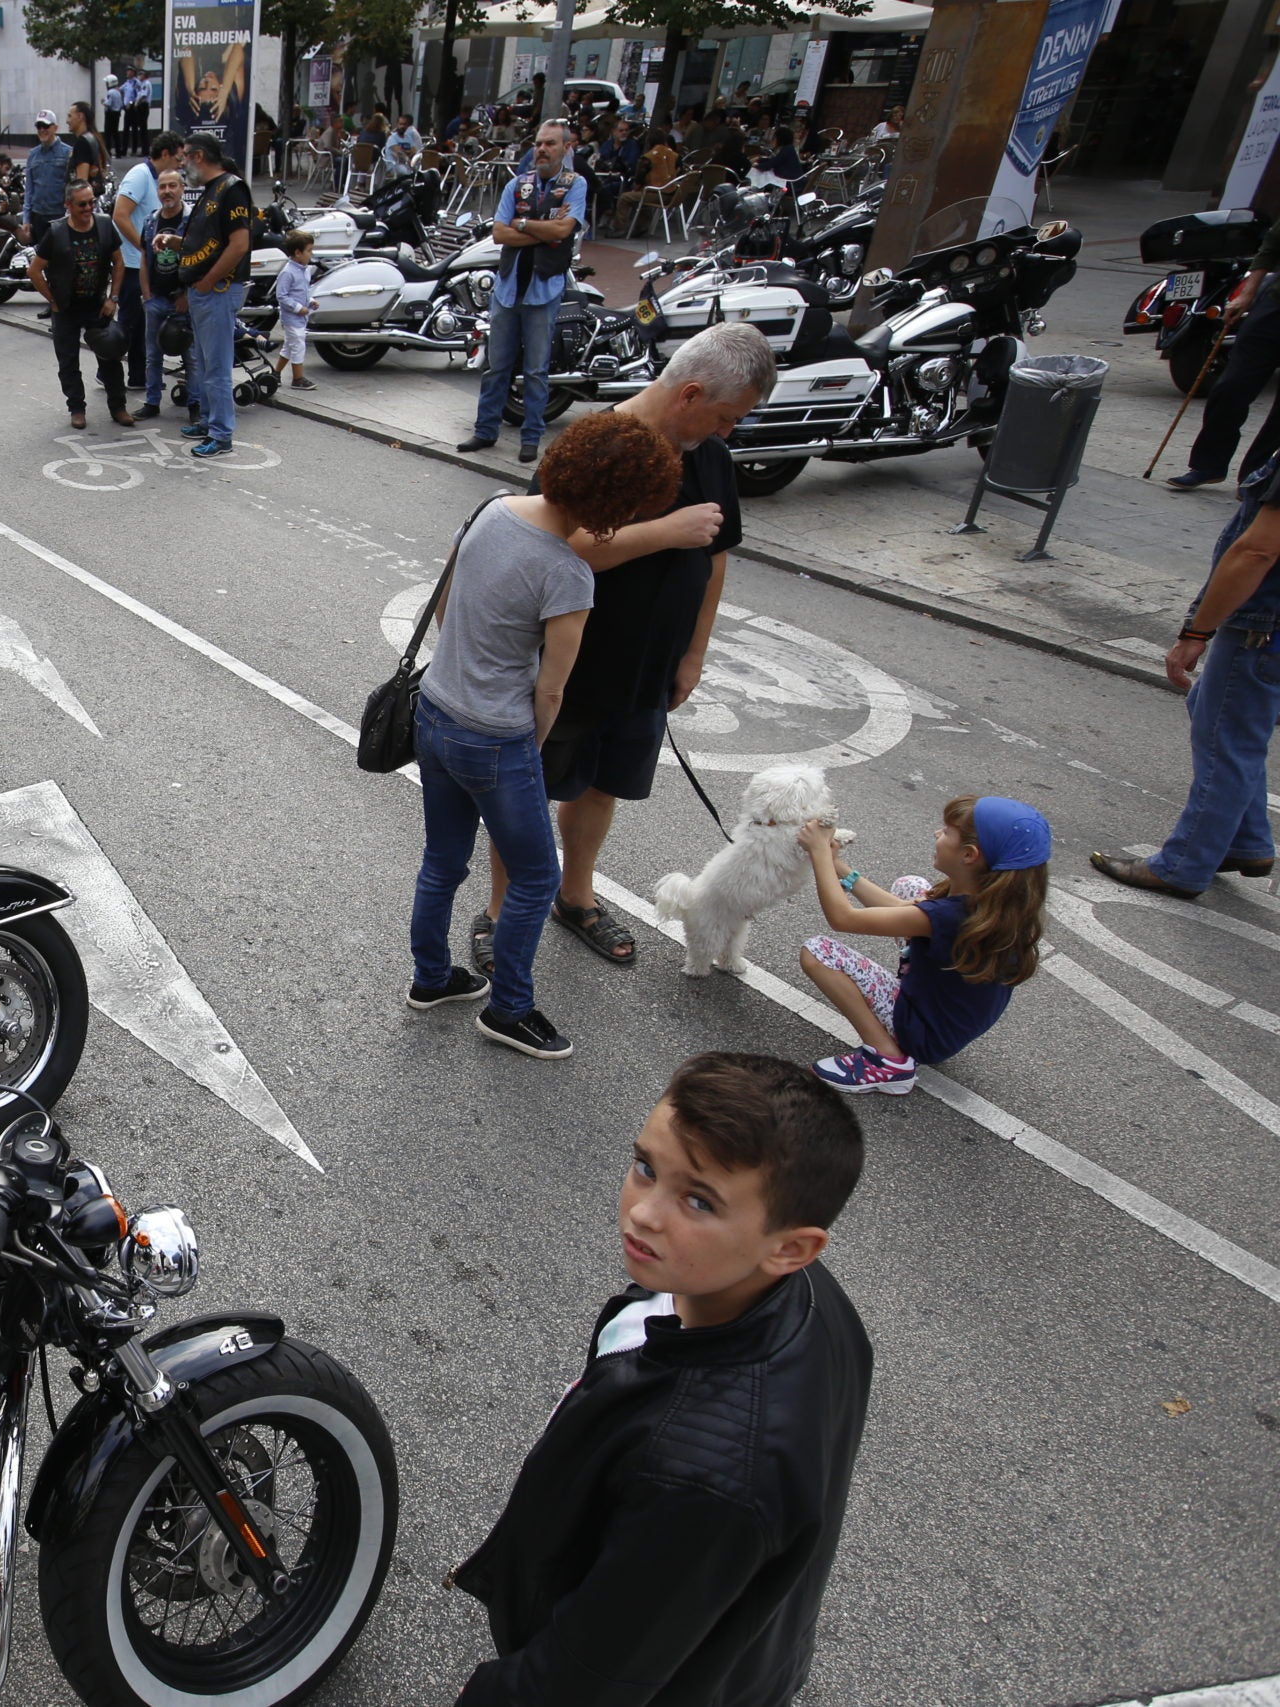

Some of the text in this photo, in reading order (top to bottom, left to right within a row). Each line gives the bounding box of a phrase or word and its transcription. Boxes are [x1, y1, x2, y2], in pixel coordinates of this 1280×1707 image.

[174, 15, 197, 29] EVA
[174, 30, 251, 46] YERBABUENA
[1036, 19, 1096, 71] DENIM
[1026, 79, 1062, 109] STREET
[1174, 273, 1201, 287] 8044
[1173, 286, 1194, 298] FBZ
[219, 1332, 254, 1355] 48
